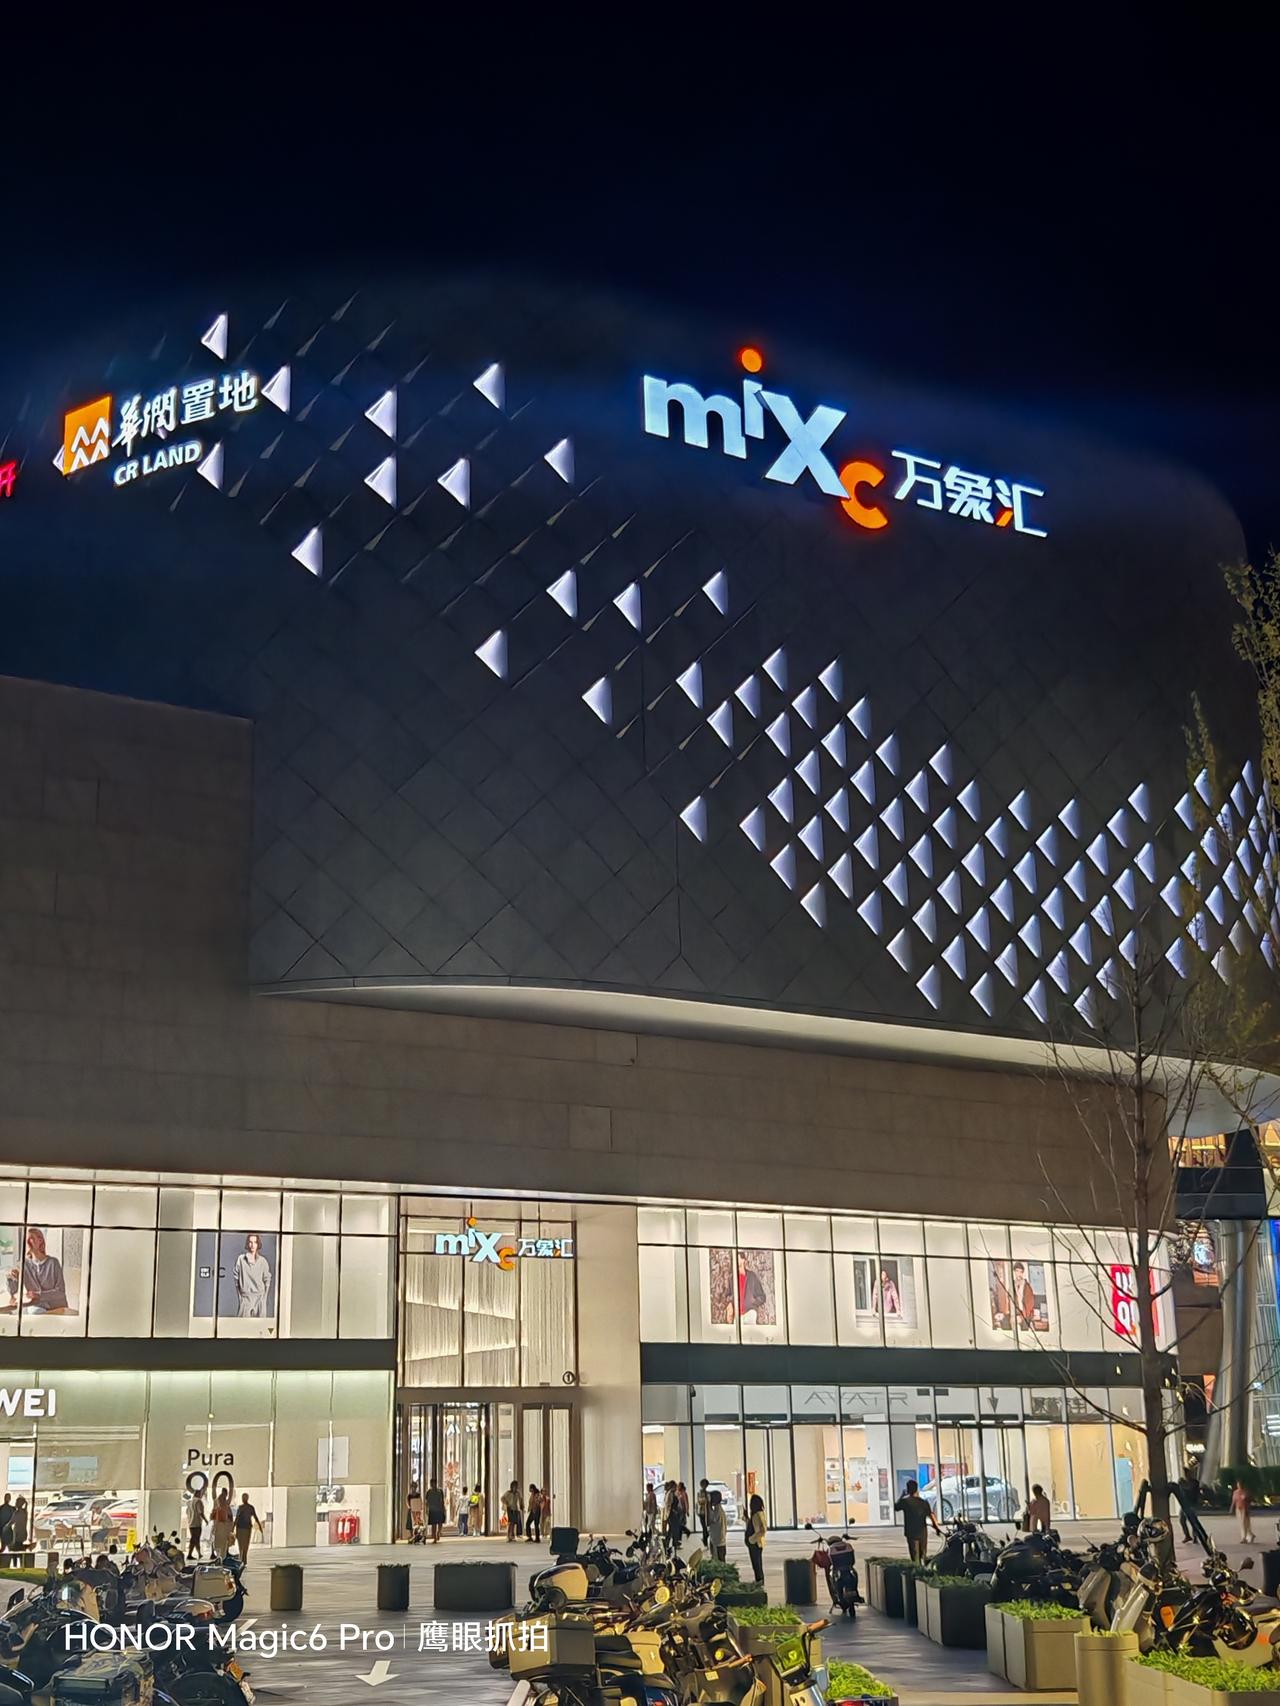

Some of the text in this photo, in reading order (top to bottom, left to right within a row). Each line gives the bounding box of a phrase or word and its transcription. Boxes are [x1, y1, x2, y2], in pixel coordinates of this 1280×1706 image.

[113, 441, 202, 486] CR LAND
[891, 449, 1047, 537] 万象汇
[517, 1238, 574, 1258] 万象汇
[187, 1448, 234, 1466] Pura
